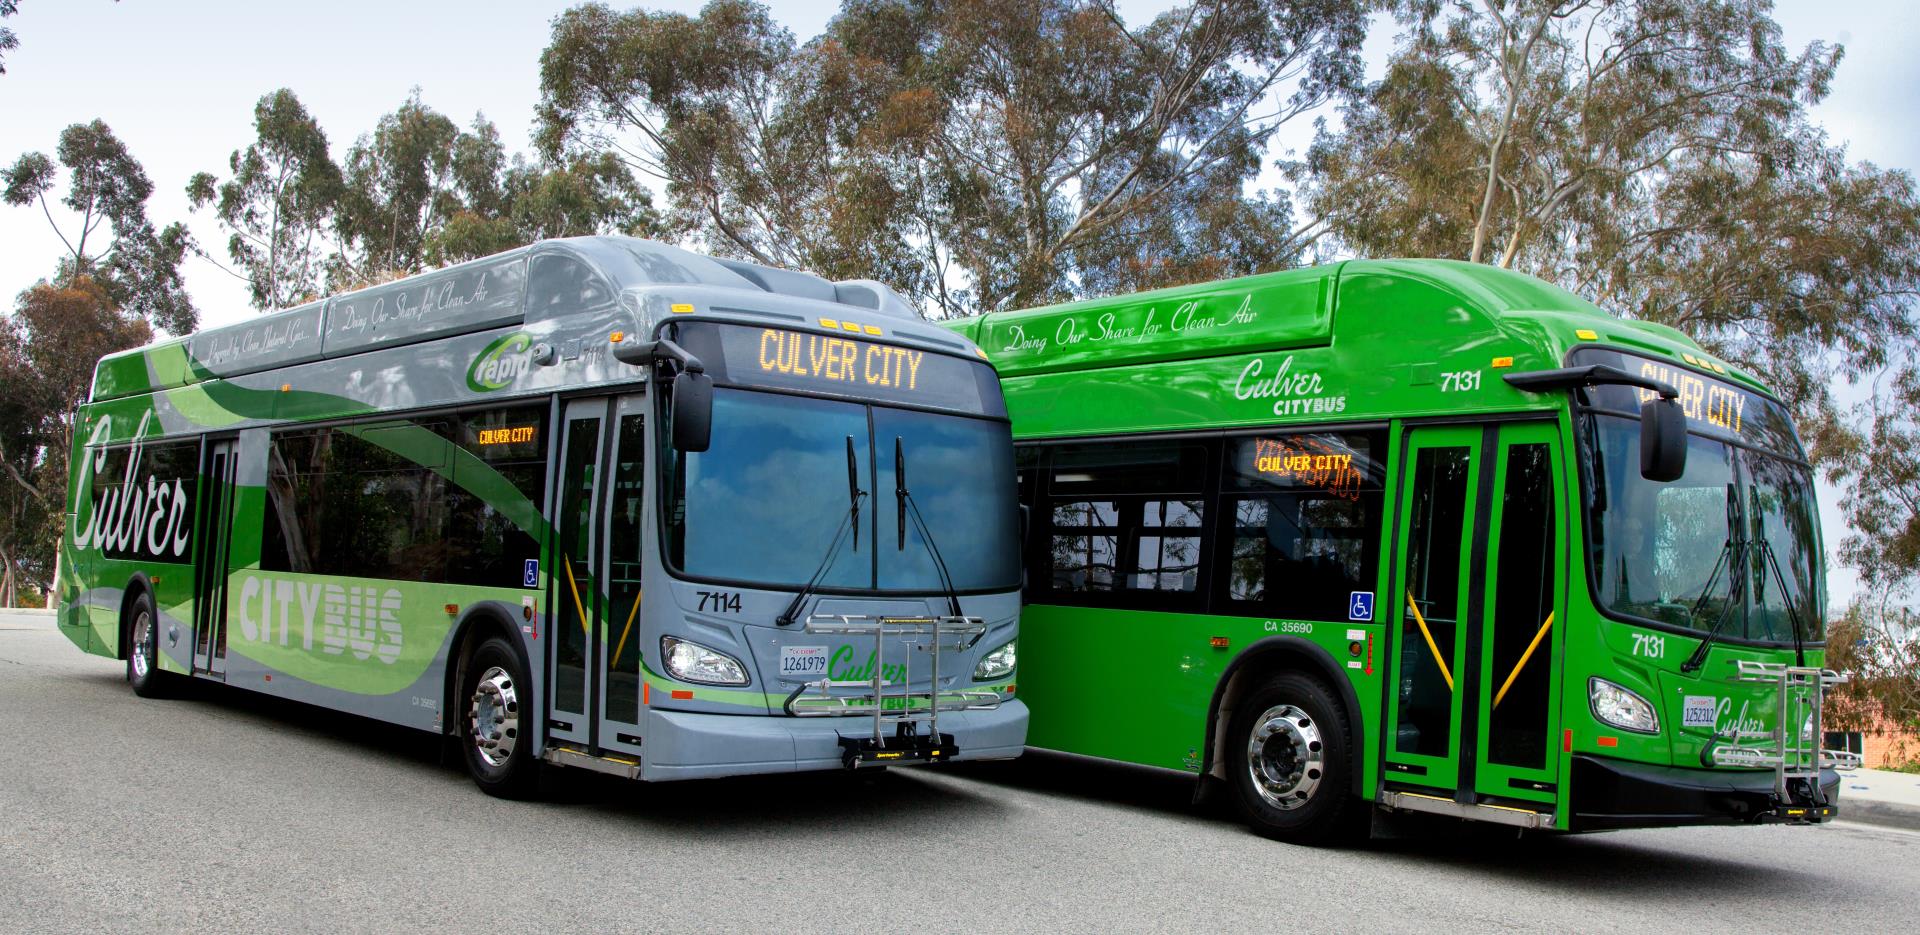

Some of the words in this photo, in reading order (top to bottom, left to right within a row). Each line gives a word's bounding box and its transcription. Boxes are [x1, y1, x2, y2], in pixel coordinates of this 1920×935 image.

[342, 305, 367, 334] Doing
[371, 297, 389, 325] Our
[391, 292, 418, 320] Share
[418, 287, 434, 321] for
[438, 281, 464, 310] Clean
[465, 272, 488, 304] Air
[1004, 325, 1048, 354] Doing
[1056, 318, 1085, 345] Our
[1089, 312, 1134, 341] Share
[1138, 307, 1162, 343] for
[1171, 301, 1215, 331] Clean
[1217, 293, 1257, 324] Air
[474, 349, 534, 384] rapid
[759, 329, 858, 382] CULVER
[864, 344, 923, 390] CITY
[1235, 355, 1323, 400] Culver
[1440, 370, 1482, 392] 7131
[1273, 396, 1346, 416] CITYBUS
[1707, 384, 1745, 432] CITY
[479, 428, 510, 445] CULVER
[511, 427, 534, 443] CITY
[1258, 455, 1311, 472] CULVER
[1315, 454, 1352, 470] CITY
[74, 408, 189, 557] Culver
[696, 591, 742, 613] 7114
[239, 575, 402, 665] CITYBUS
[1264, 620, 1278, 631] CA
[1281, 621, 1313, 633] 35690
[1631, 633, 1664, 658] 7131
[783, 656, 826, 671] 1261979
[1685, 707, 1714, 722] 1252312
